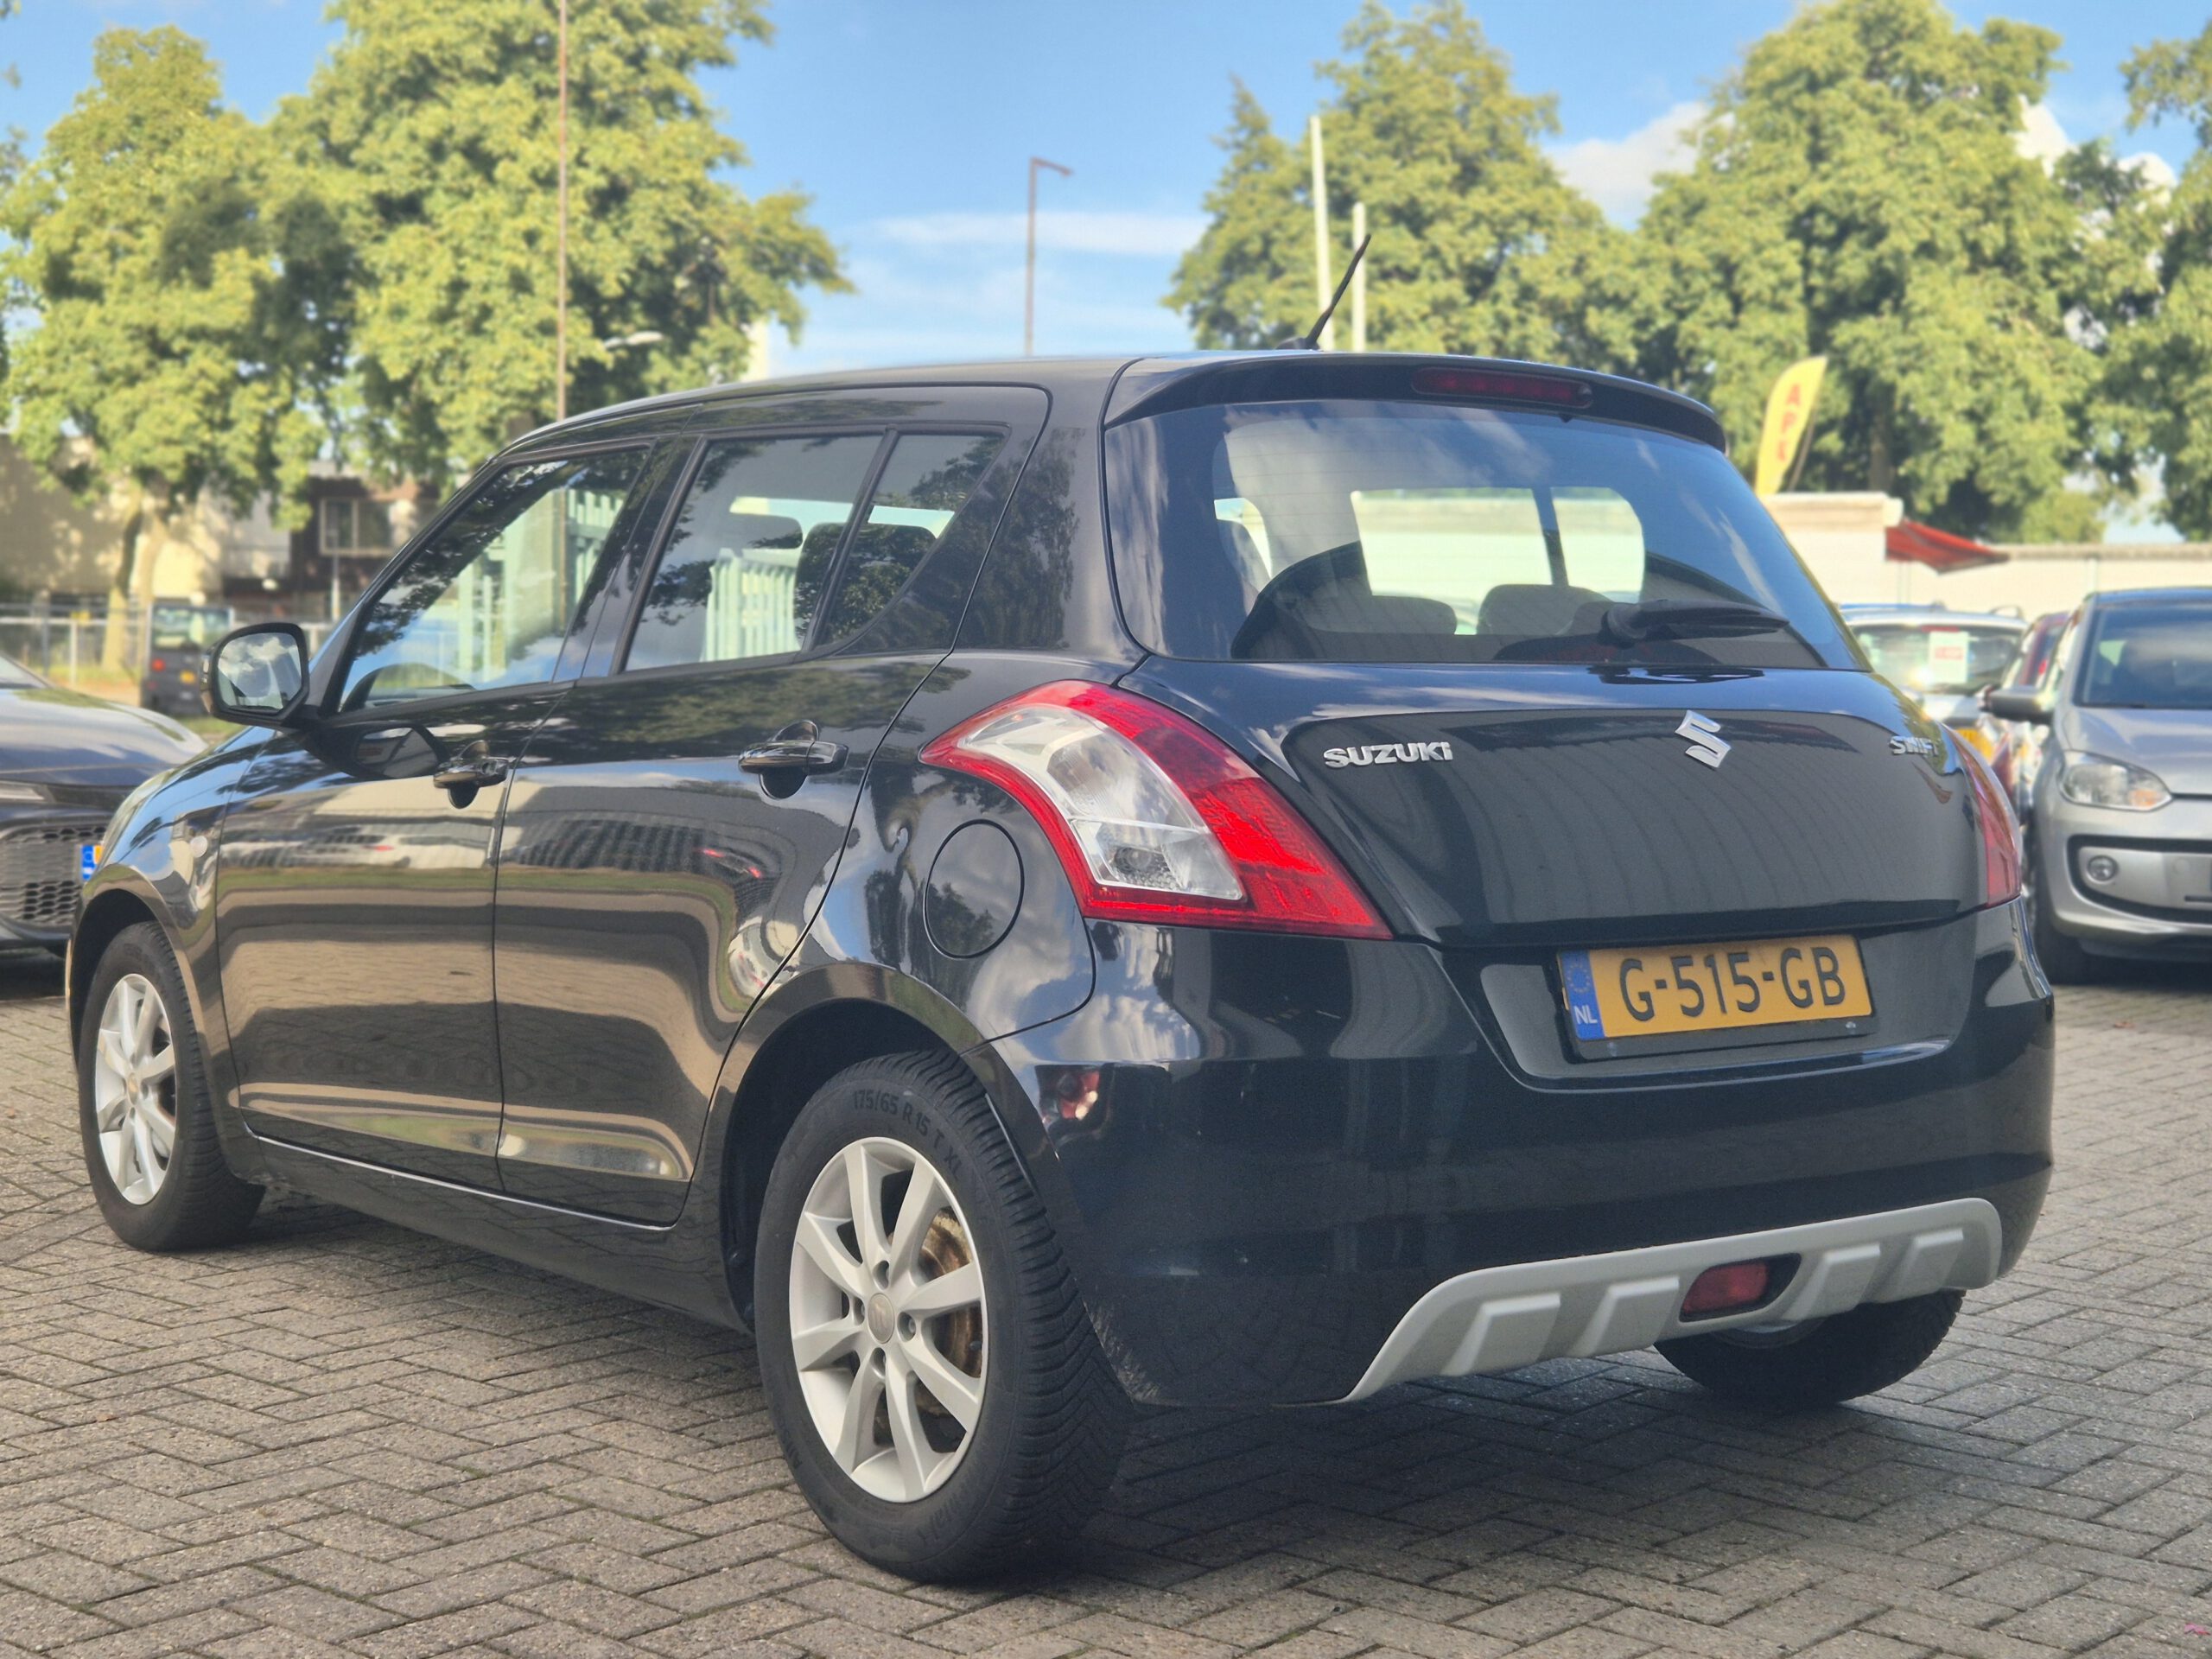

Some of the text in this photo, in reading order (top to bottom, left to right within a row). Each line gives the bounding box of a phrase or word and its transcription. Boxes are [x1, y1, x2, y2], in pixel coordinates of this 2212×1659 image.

[1323, 741, 1453, 768] SUZUKI
[1619, 946, 1846, 1021] G-515-GB
[1573, 1005, 1598, 1026] NL
[853, 1089, 899, 1116] 175/65
